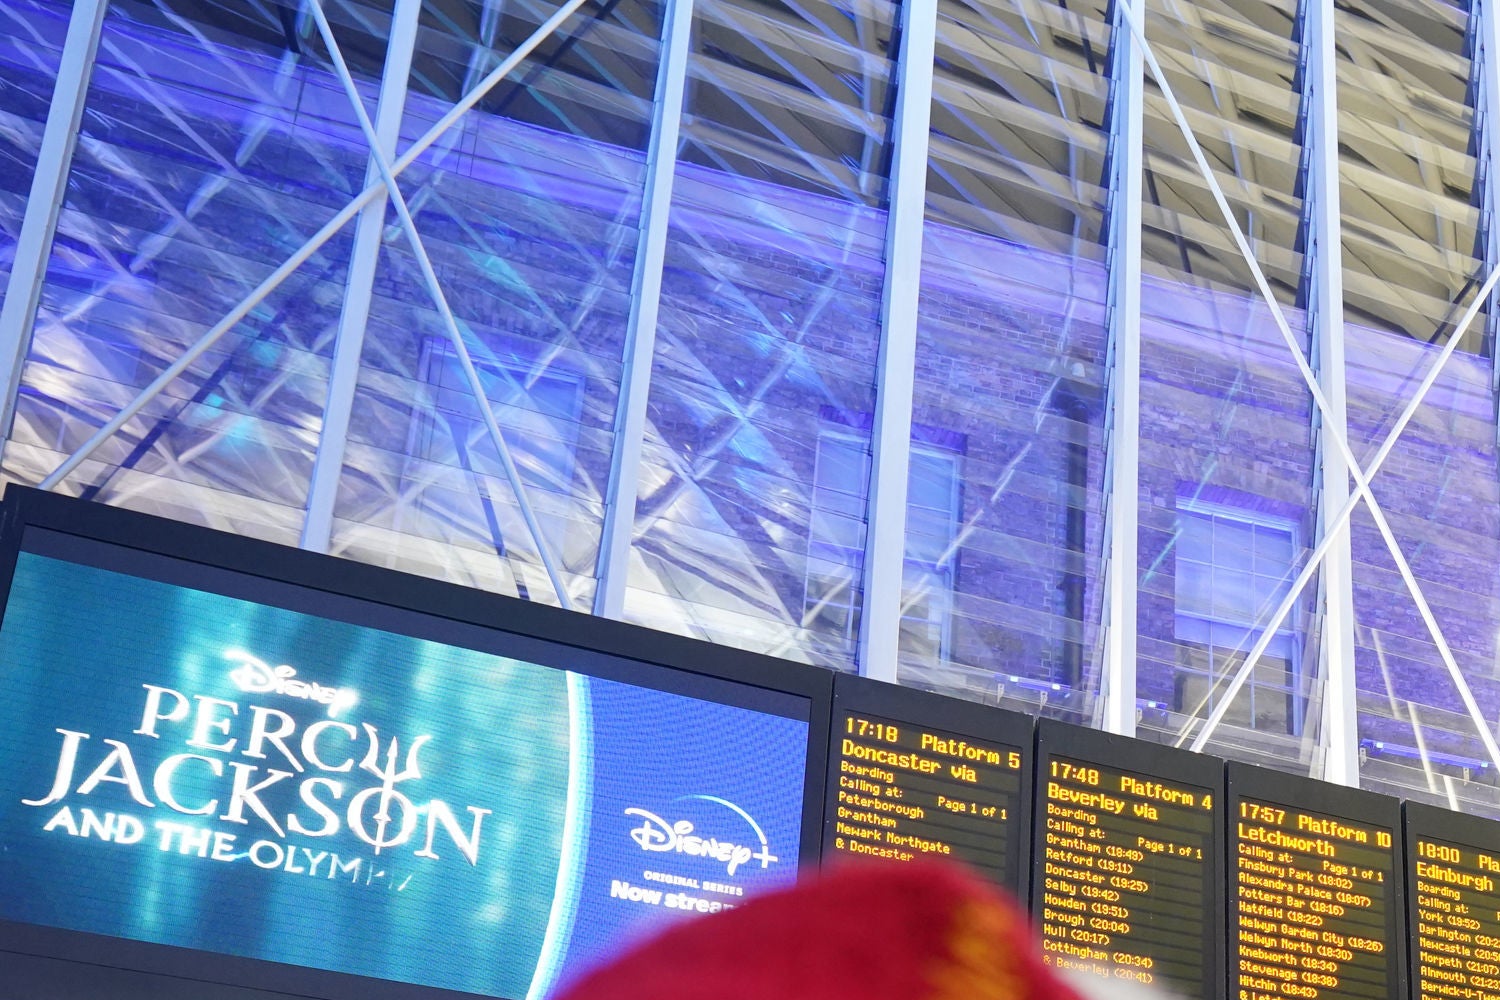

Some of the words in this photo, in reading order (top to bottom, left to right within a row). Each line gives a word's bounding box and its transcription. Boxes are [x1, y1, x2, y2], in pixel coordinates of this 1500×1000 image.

[847, 717, 898, 743] 17:18
[921, 733, 1000, 764] Platform
[1008, 752, 1020, 769] 5
[840, 760, 894, 784] Boarding
[842, 738, 942, 773] Doncaster
[950, 765, 977, 782] via
[22, 728, 493, 867] JACKSON
[1051, 762, 1099, 786] 17:48
[1120, 776, 1194, 806] Platform
[1201, 794, 1212, 810] 4
[838, 790, 924, 819] Peterborough
[1047, 781, 1125, 814] Beverley
[1133, 803, 1158, 820] via
[837, 806, 897, 827] Grantham
[1047, 802, 1097, 825] Boarding
[1240, 802, 1285, 825] 17:57
[1298, 814, 1367, 843] Platform
[1375, 831, 1392, 848] 10
[44, 806, 144, 845] AND
[156, 821, 237, 862] THE
[836, 821, 882, 840] Newark
[886, 831, 950, 855] Northgate
[1046, 832, 1101, 853] Grantham
[1238, 822, 1335, 857] Letchworth
[835, 837, 845, 849] &
[849, 840, 914, 862] Doncaster
[1046, 847, 1093, 867] Retford
[1418, 841, 1460, 864] 18:00
[1045, 862, 1106, 884] Doncaster
[1238, 856, 1285, 878] Finsbury
[1287, 867, 1314, 882] Park
[1416, 861, 1493, 892] Edinburgh
[611, 880, 662, 905] Now
[644, 871, 700, 889] ORIGINAL
[703, 880, 743, 896] SERIES
[1045, 877, 1076, 896] Selby
[1238, 871, 1294, 893] Alexandra
[1296, 883, 1333, 900] Palace
[1417, 880, 1461, 901] Boarding
[1044, 893, 1087, 911] Howden
[1238, 885, 1283, 904] Potters
[1284, 895, 1306, 909] Bar
[1044, 908, 1085, 927] Brough
[1238, 900, 1283, 919] Hatfield
[1418, 909, 1444, 923] York
[1043, 923, 1066, 938] Hull
[1418, 922, 1472, 943] Darlington
[1043, 939, 1108, 962] Cottingham
[1113, 951, 1153, 969] (20:34)
[1419, 936, 1471, 956] Newcastle
[1419, 951, 1462, 969] Morpeth
